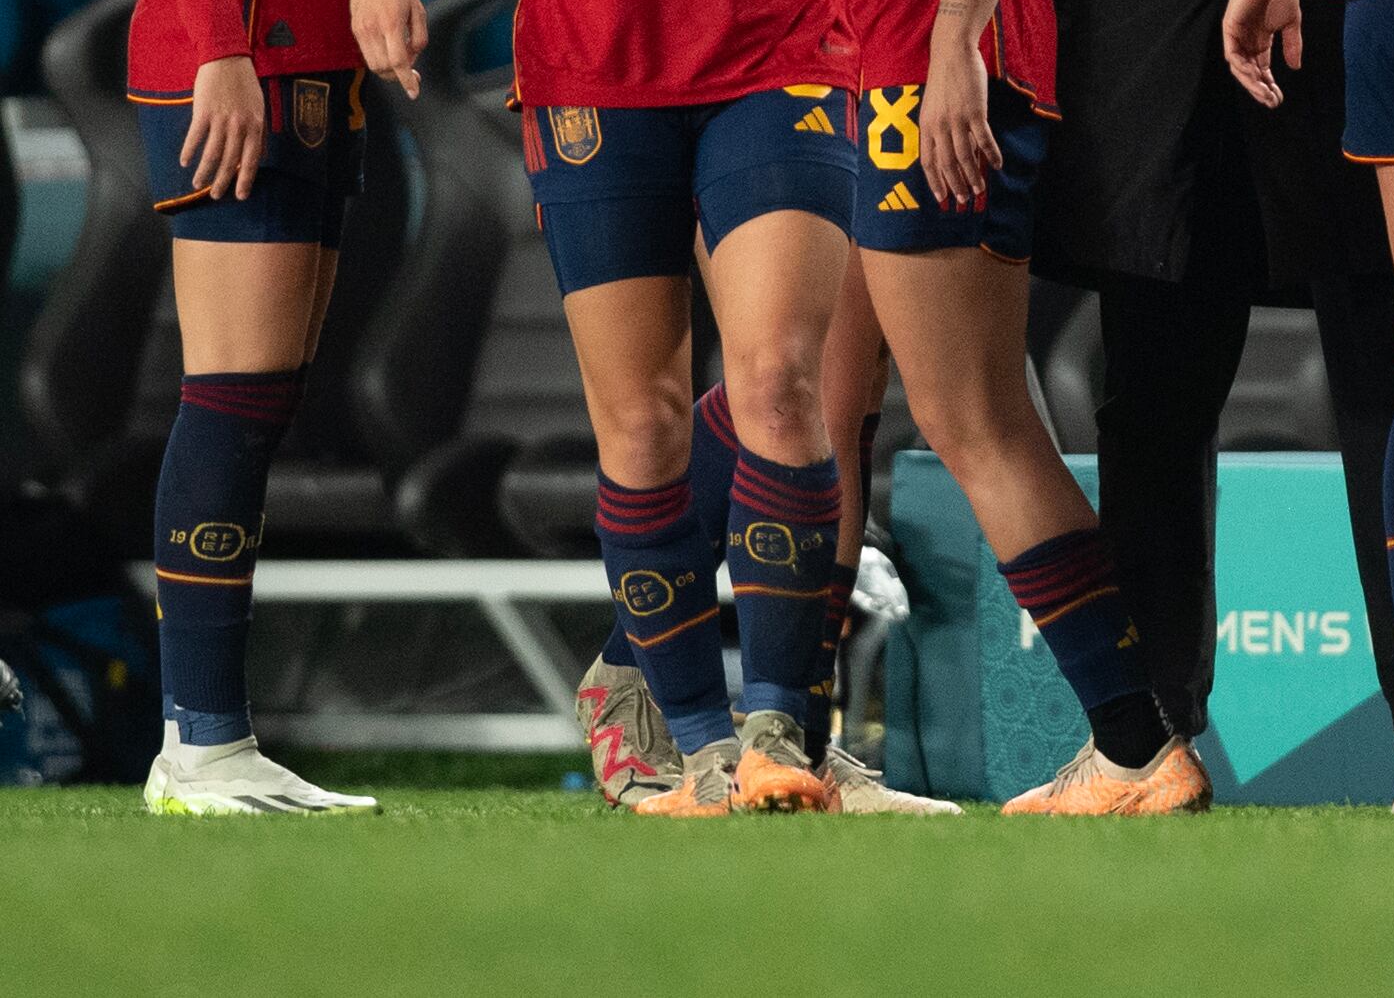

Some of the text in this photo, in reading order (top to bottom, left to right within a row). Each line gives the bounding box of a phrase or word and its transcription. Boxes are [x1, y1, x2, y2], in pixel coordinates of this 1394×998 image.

[867, 84, 920, 170] 8
[170, 529, 186, 543] 19
[728, 532, 743, 546] 19
